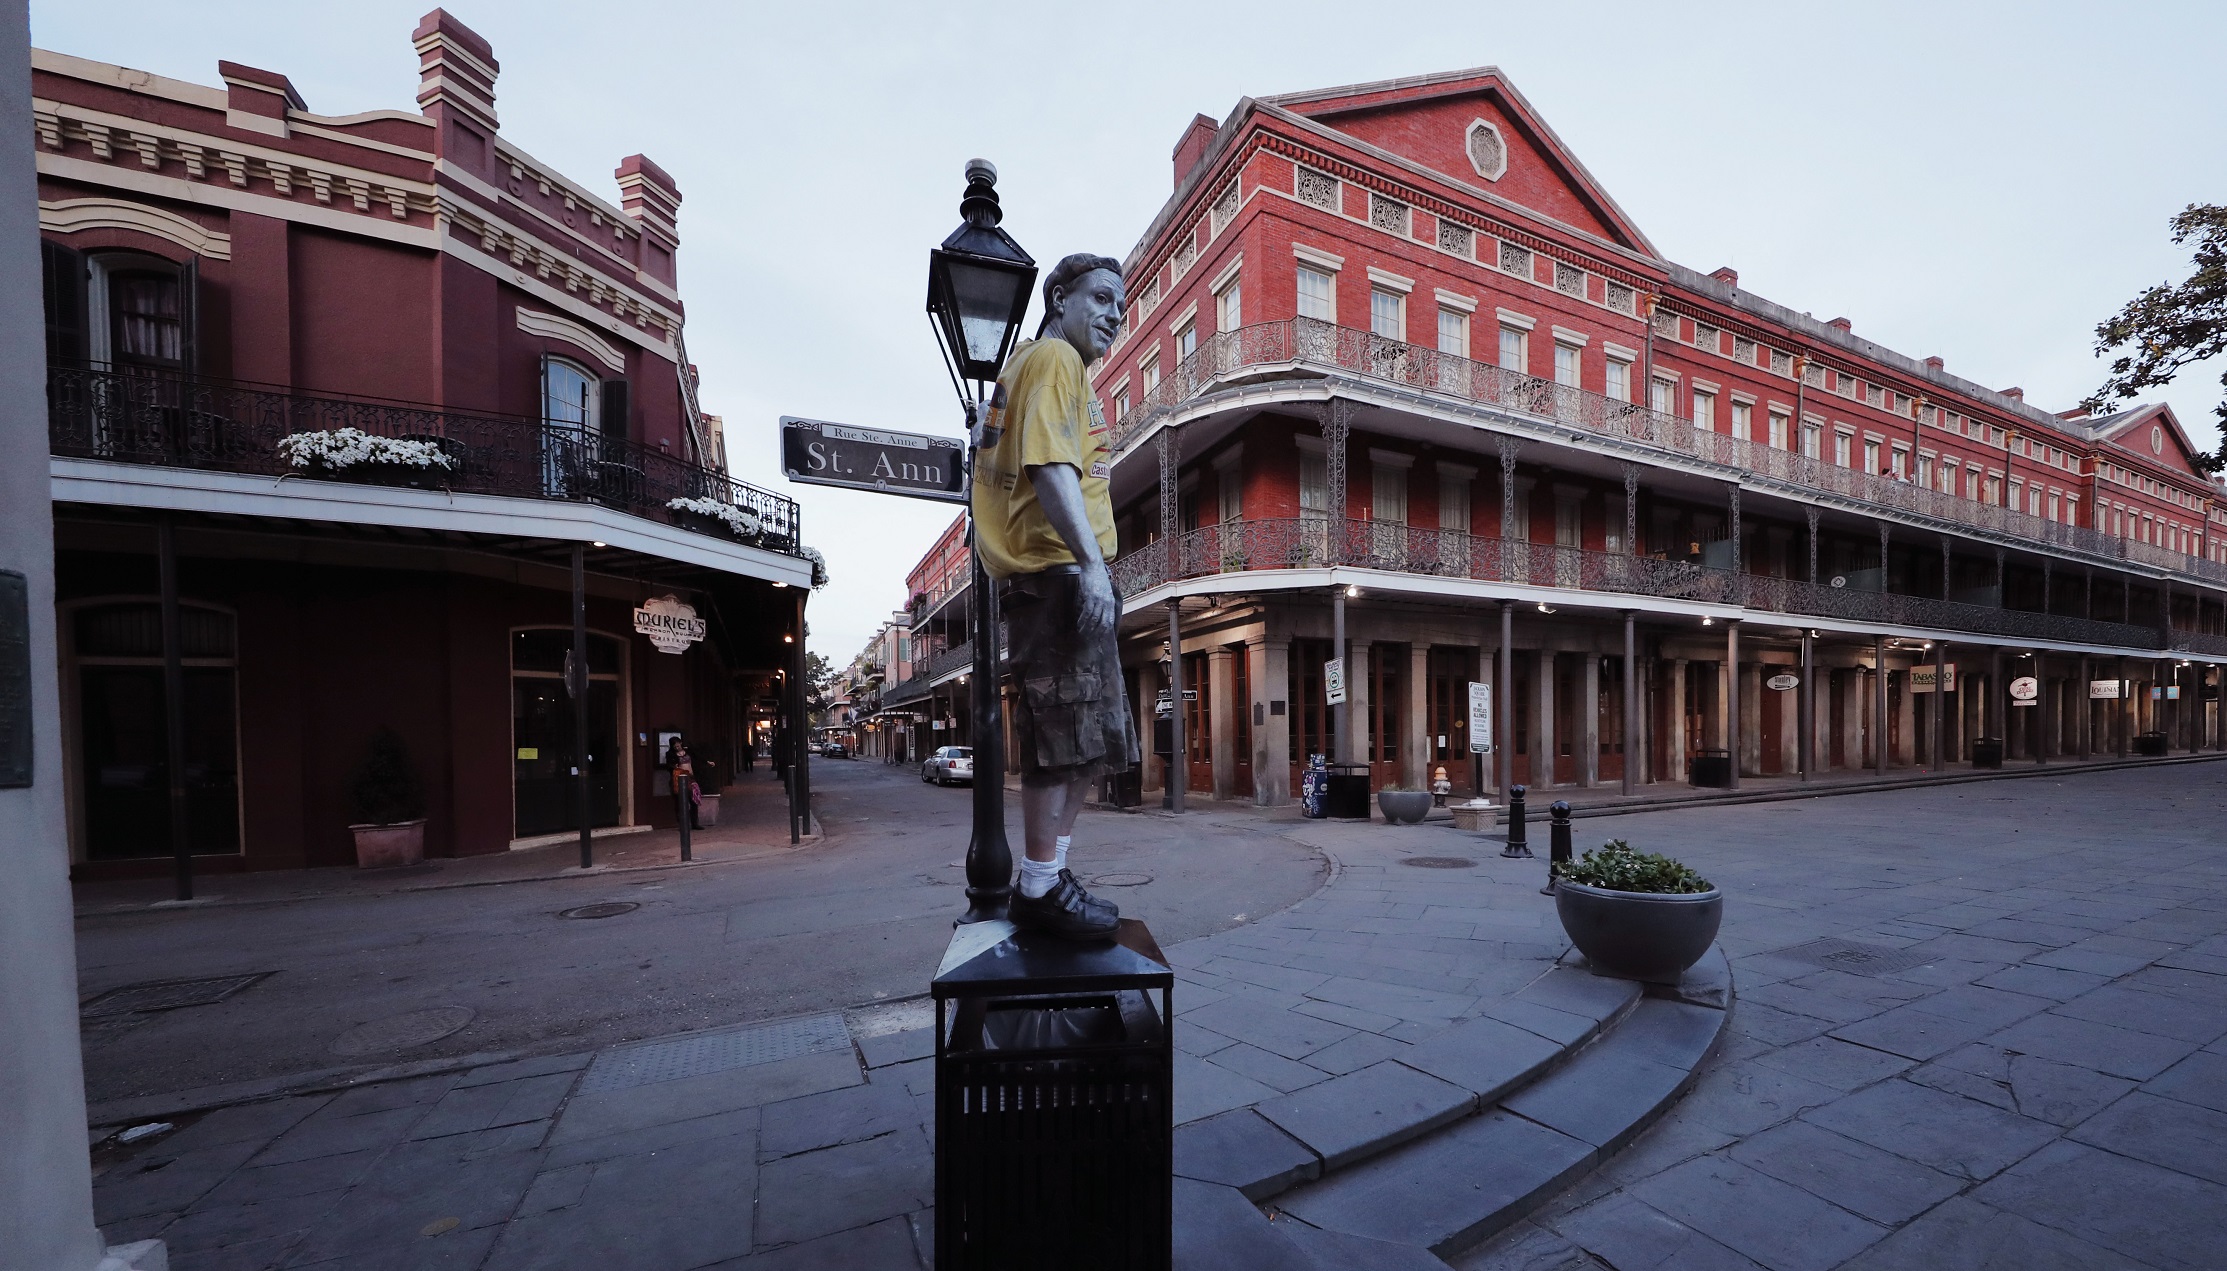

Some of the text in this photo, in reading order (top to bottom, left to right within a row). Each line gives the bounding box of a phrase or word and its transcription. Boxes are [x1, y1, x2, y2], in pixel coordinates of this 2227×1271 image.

[834, 427, 918, 447] Rue Ste. Anne
[807, 441, 853, 474] St.
[870, 451, 943, 484] Ann
[636, 612, 704, 637] MURIEL'S
[1911, 672, 1953, 681] TABASO
